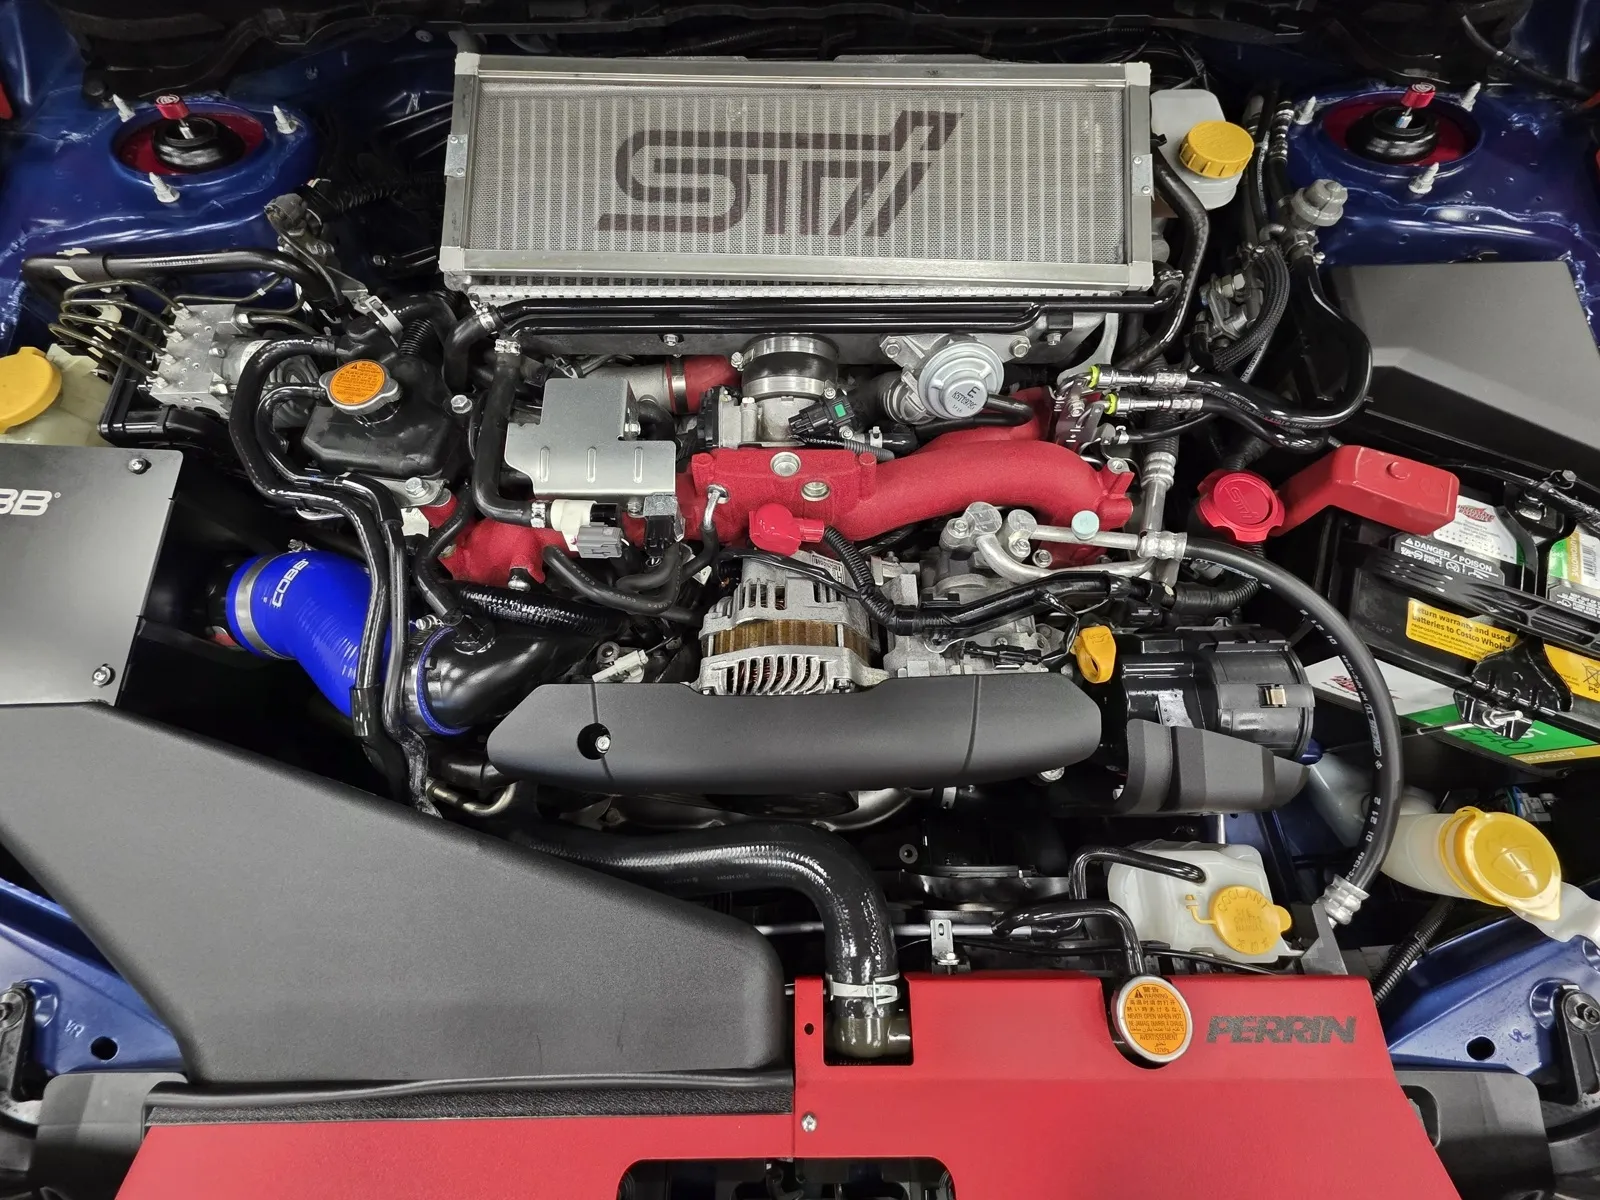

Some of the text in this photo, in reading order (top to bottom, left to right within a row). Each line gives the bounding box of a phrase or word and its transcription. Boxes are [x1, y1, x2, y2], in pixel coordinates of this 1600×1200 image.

[967, 386, 980, 398] E
[1414, 540, 1450, 557] DANGER
[1459, 555, 1492, 572] POISON
[1570, 535, 1580, 578] AUTOMOTIVE
[272, 559, 309, 608] COBB
[1412, 615, 1445, 630] batteries
[1446, 625, 1455, 633] to
[1456, 628, 1480, 642] Costco
[1413, 604, 1511, 643] eturn warranty and used
[1588, 686, 1599, 694] Pb
[1365, 831, 1375, 843] DI
[1370, 810, 1379, 824] 21
[1217, 889, 1271, 912] COOLANT
[1206, 1015, 1357, 1043] PERRIN
